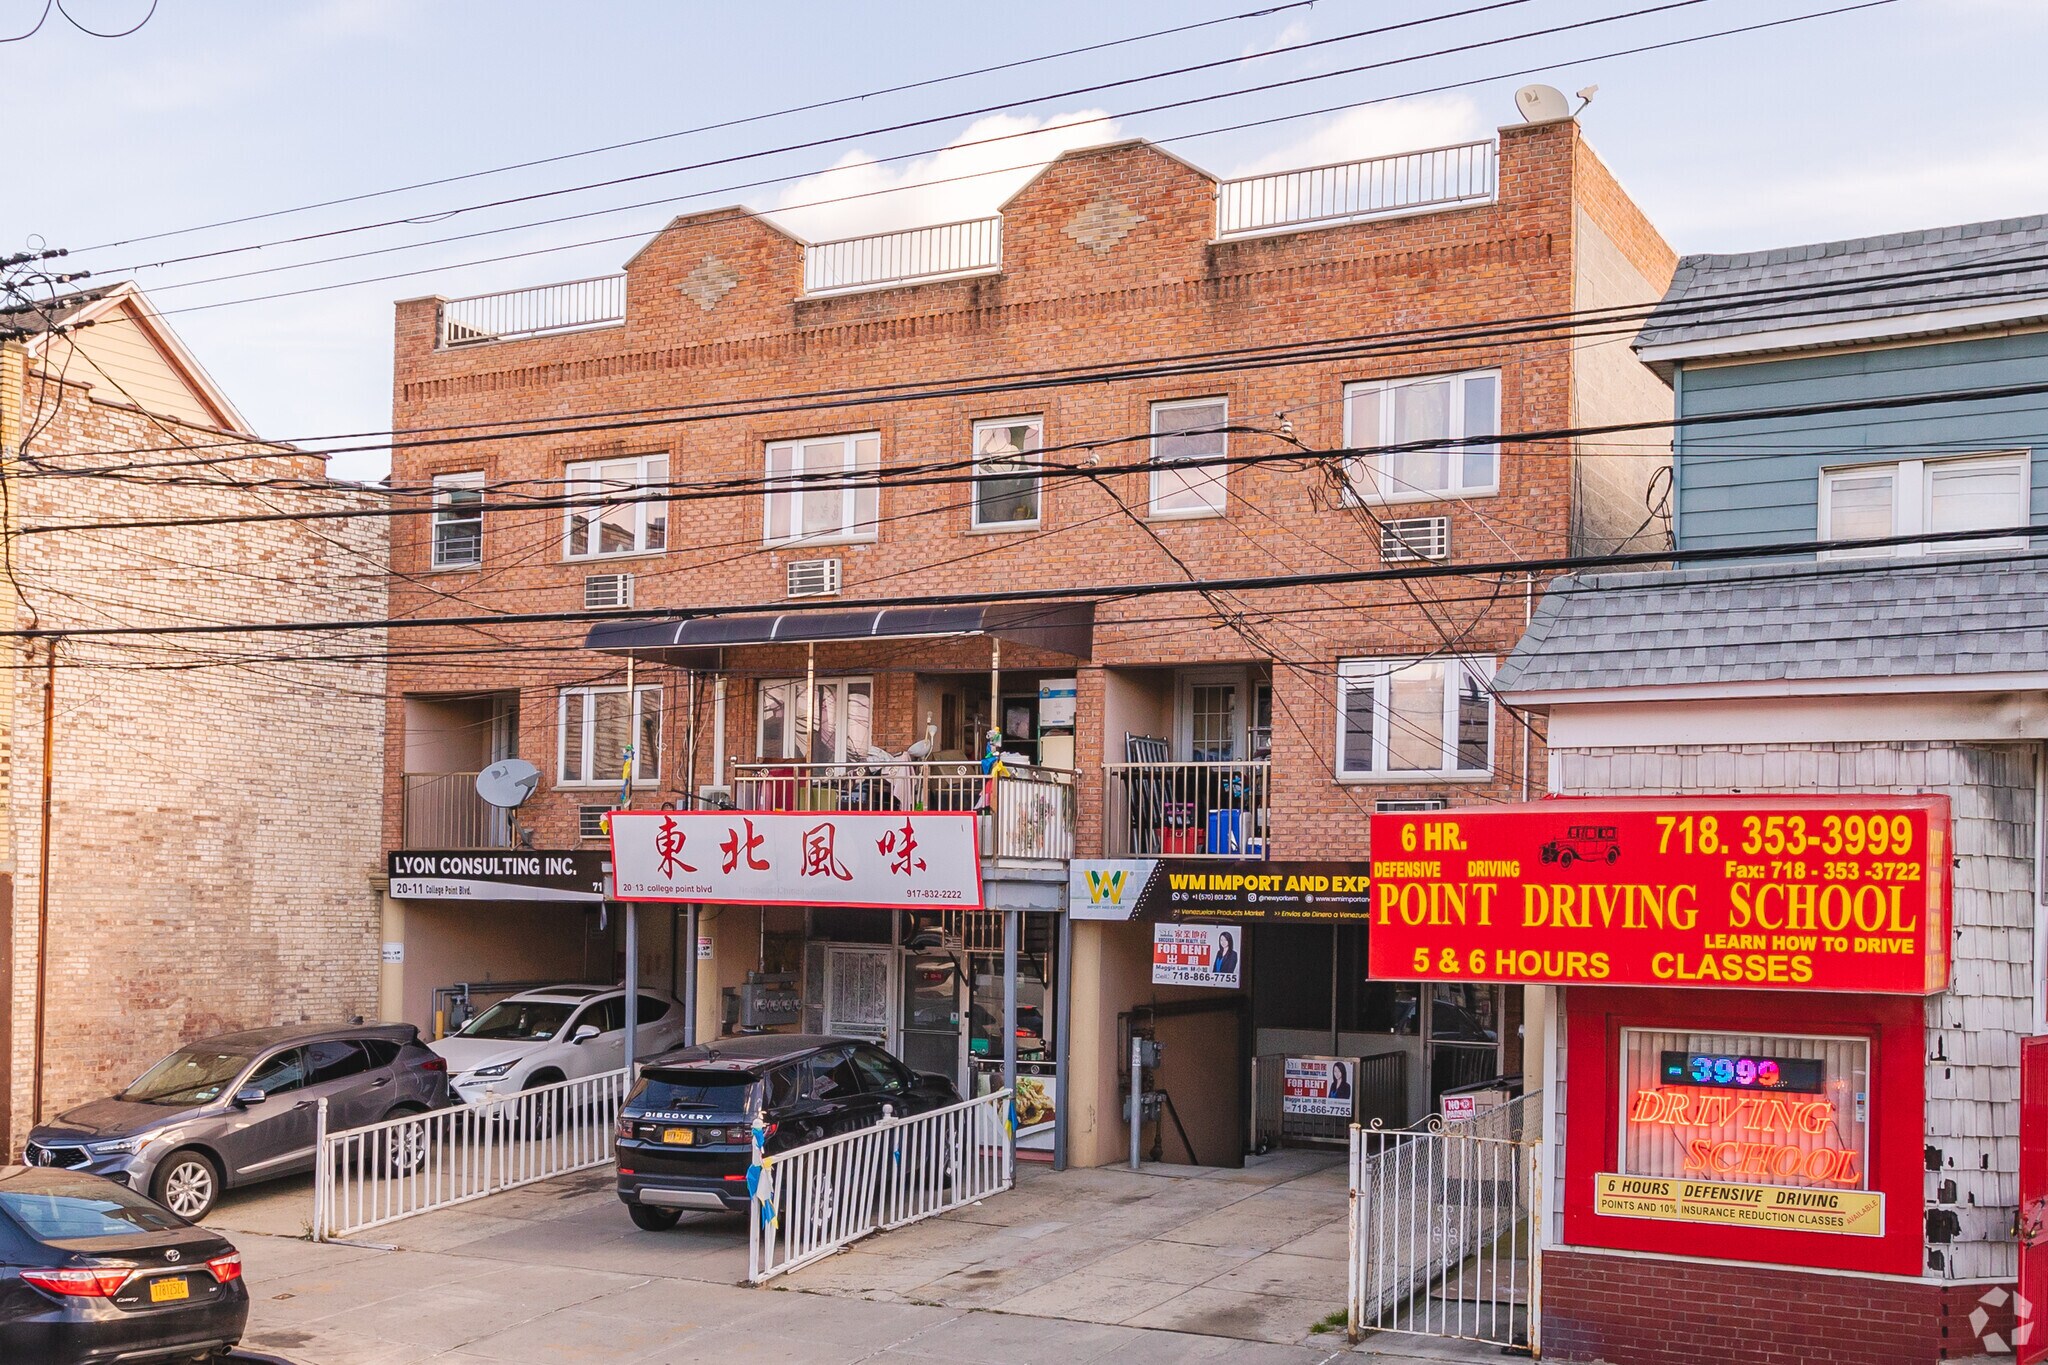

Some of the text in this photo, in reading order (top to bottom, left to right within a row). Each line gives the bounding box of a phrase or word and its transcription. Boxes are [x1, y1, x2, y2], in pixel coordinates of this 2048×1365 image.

[1402, 822, 1468, 852] 6 HR.
[1655, 815, 1913, 855] 718. 353-3999
[655, 815, 928, 881] 東北風味
[395, 856, 577, 876] LYON CONSULTING INC.
[1374, 860, 1521, 878] DEFENSIVE DRIVING
[1725, 861, 1766, 879] Fax:
[1770, 861, 1806, 879] 718
[1823, 862, 1860, 880] 353
[396, 882, 472, 896] 20-11 College Point Blvd.
[592, 882, 603, 892] 71
[647, 885, 674, 894] college
[675, 885, 695, 894] point
[1169, 874, 1371, 892] WM IMPORT AND EXP
[906, 889, 962, 899] 917-832-2222
[1198, 893, 1214, 901] (570)
[1377, 881, 1917, 932] POINT DRIVING SCHOOL
[1157, 943, 1209, 955] FOR RENT
[1704, 933, 1915, 954] LEARN HOW TO DRIVE
[1413, 948, 1813, 982] 5 & 6 HOURS CLASSES
[1172, 972, 1237, 983] 718-866-7755
[1692, 1057, 1780, 1086] 3999
[1287, 1079, 1326, 1089] FOR RENT
[1291, 1104, 1351, 1116] 718-866-7755
[1447, 1099, 1460, 1110] NO
[1630, 1090, 1832, 1135] DRIVING
[645, 1111, 713, 1120] DISCOVERY
[1446, 1109, 1473, 1119] PARKING
[1683, 1138, 1861, 1184] SCHOOL
[1608, 1179, 1670, 1196] 6 HOURS
[1684, 1184, 1839, 1209] DEFENSIVE DRIVING
[1601, 1199, 1845, 1227] POINTS AND 10% INSURANCE REDUCTION CLASSES
[1846, 1199, 1879, 1227] AVAILABLE
